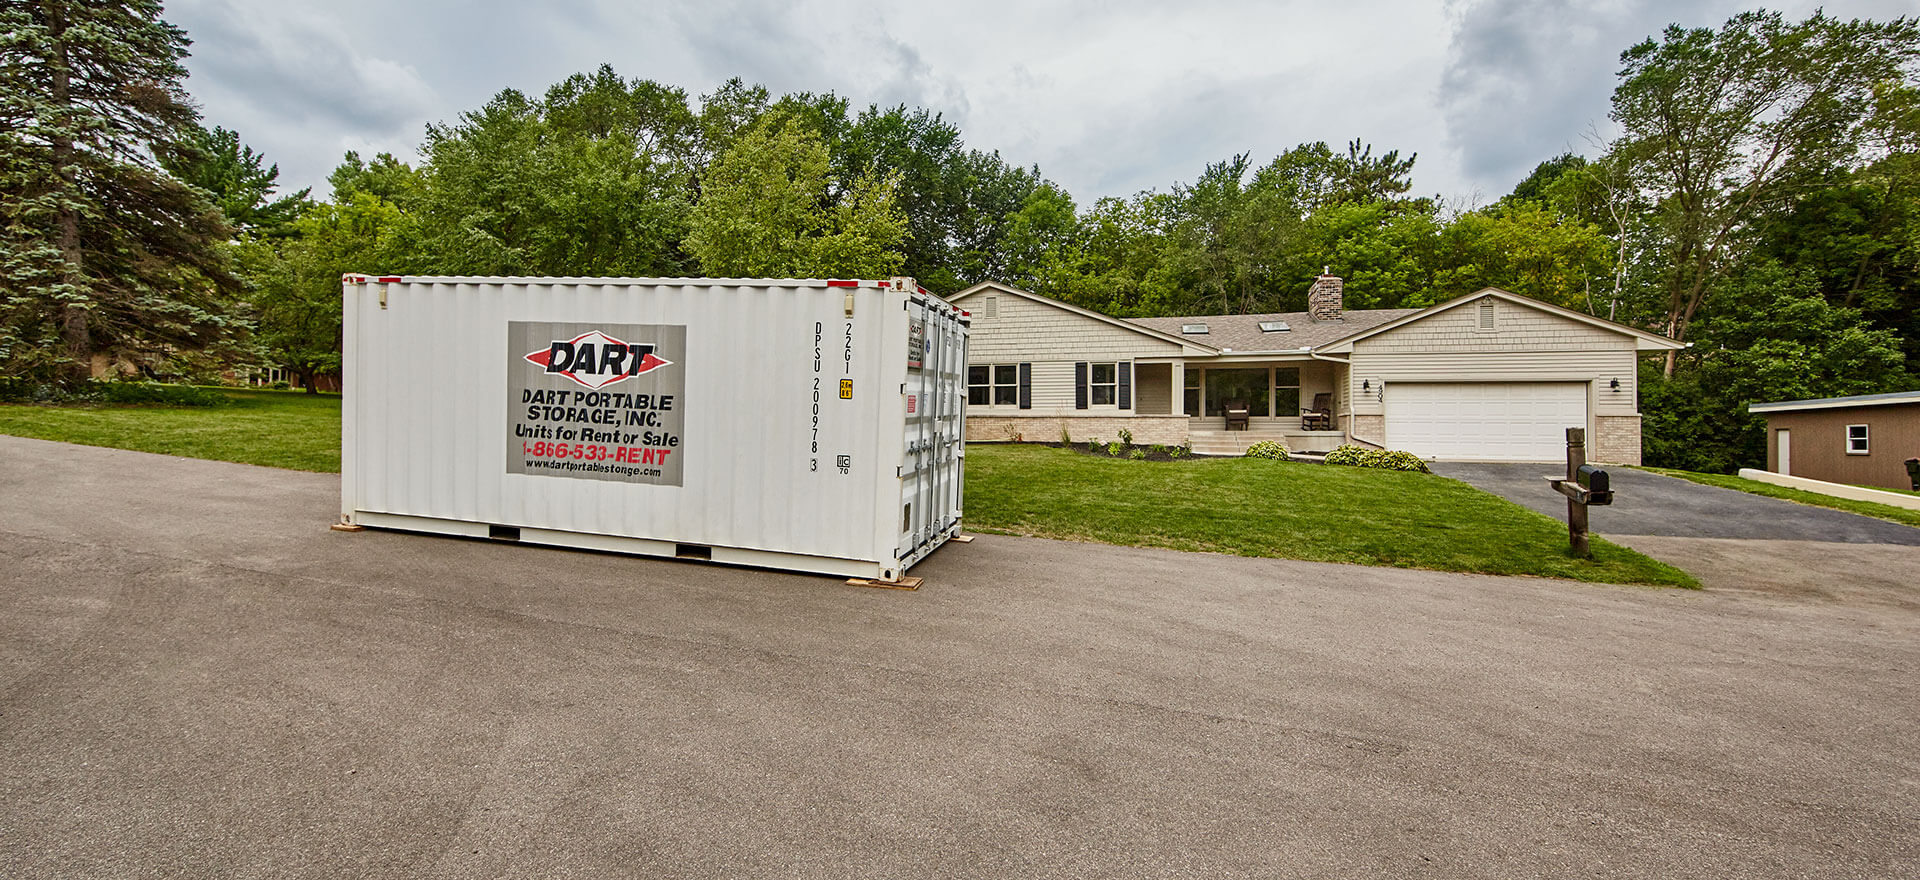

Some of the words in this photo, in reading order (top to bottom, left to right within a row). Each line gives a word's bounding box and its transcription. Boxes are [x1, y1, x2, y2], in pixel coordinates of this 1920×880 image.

[814, 321, 822, 372] DPSU
[844, 322, 852, 374] 22G1
[546, 342, 655, 377] DART
[522, 389, 571, 406] DART
[574, 392, 674, 411] PORTABLE
[527, 405, 621, 428] STORAGE,
[624, 411, 662, 428] INC.
[811, 377, 820, 454] 200978
[515, 423, 552, 440] Units
[555, 426, 578, 441] for
[580, 428, 620, 444] Rent
[623, 432, 639, 445] or
[642, 431, 679, 447] Sale
[522, 440, 672, 466] 1-866-533-RENT
[810, 458, 818, 472] 3
[525, 458, 662, 477] www.dartportablestorage.com
